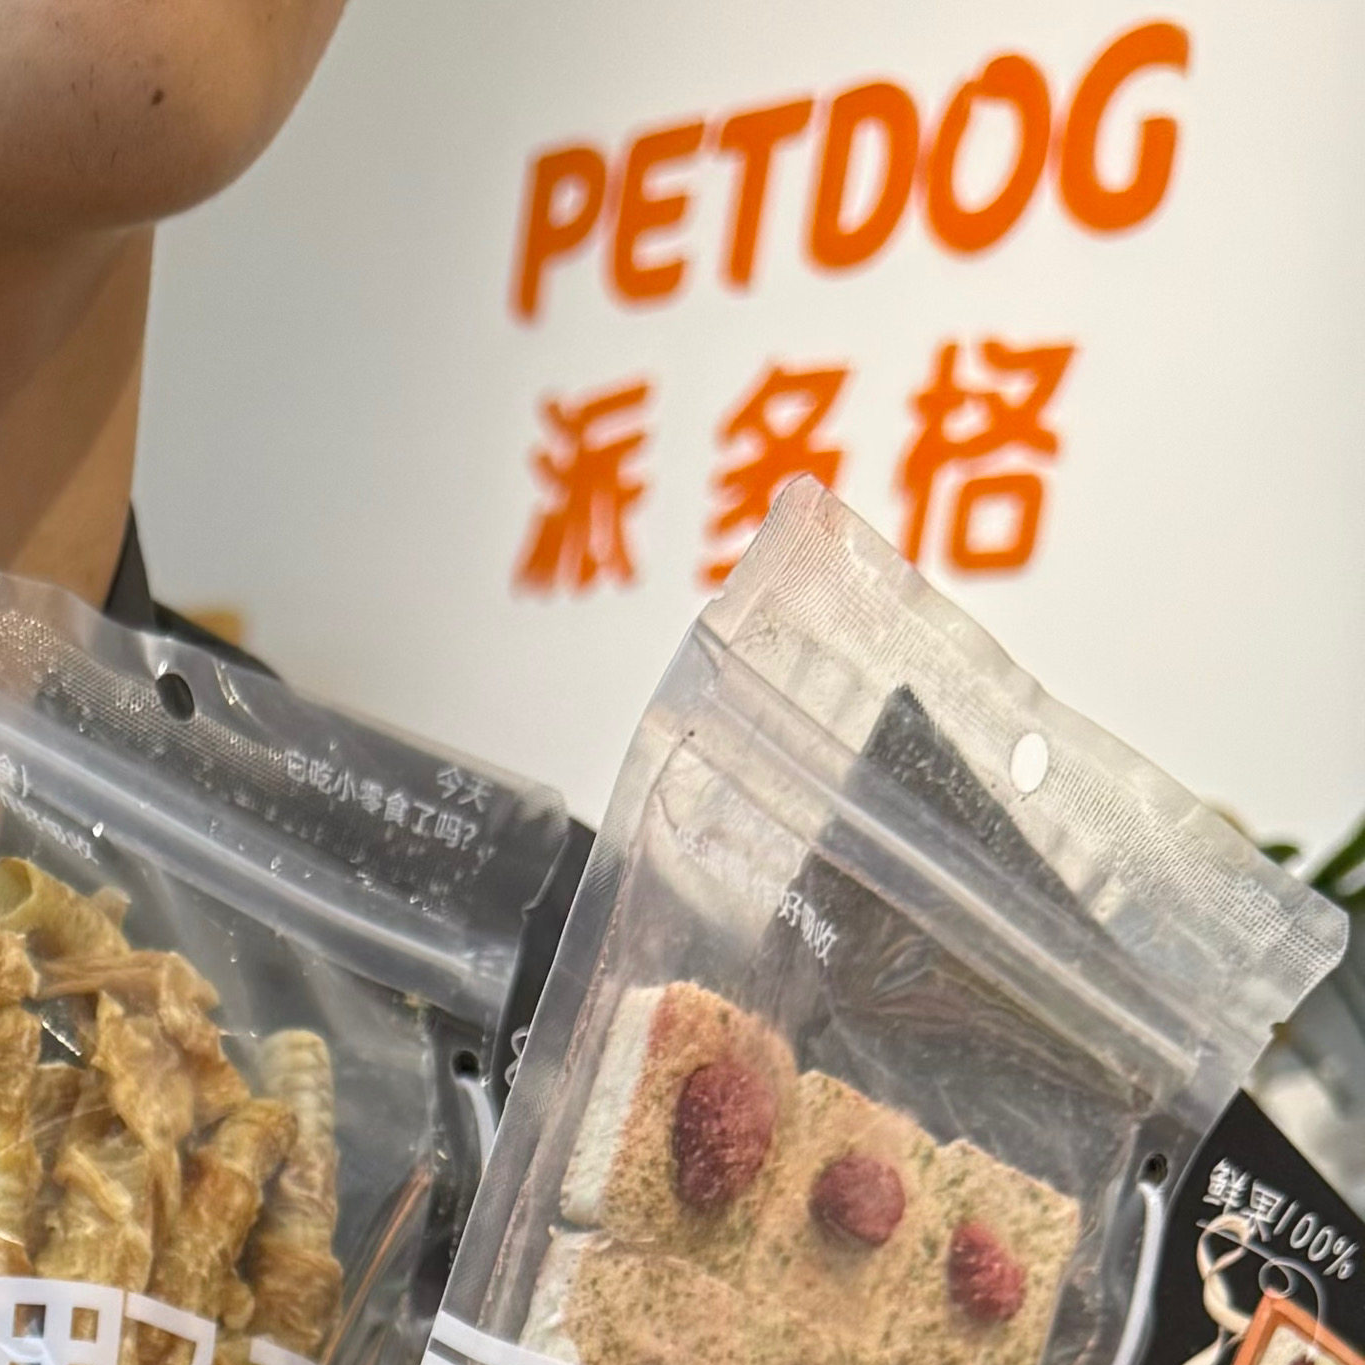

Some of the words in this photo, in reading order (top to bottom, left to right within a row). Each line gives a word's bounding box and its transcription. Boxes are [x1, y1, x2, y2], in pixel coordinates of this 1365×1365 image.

[511, 20, 1190, 324] PETDOG
[513, 337, 1078, 598] 派多格
[437, 766, 495, 813] 今天
